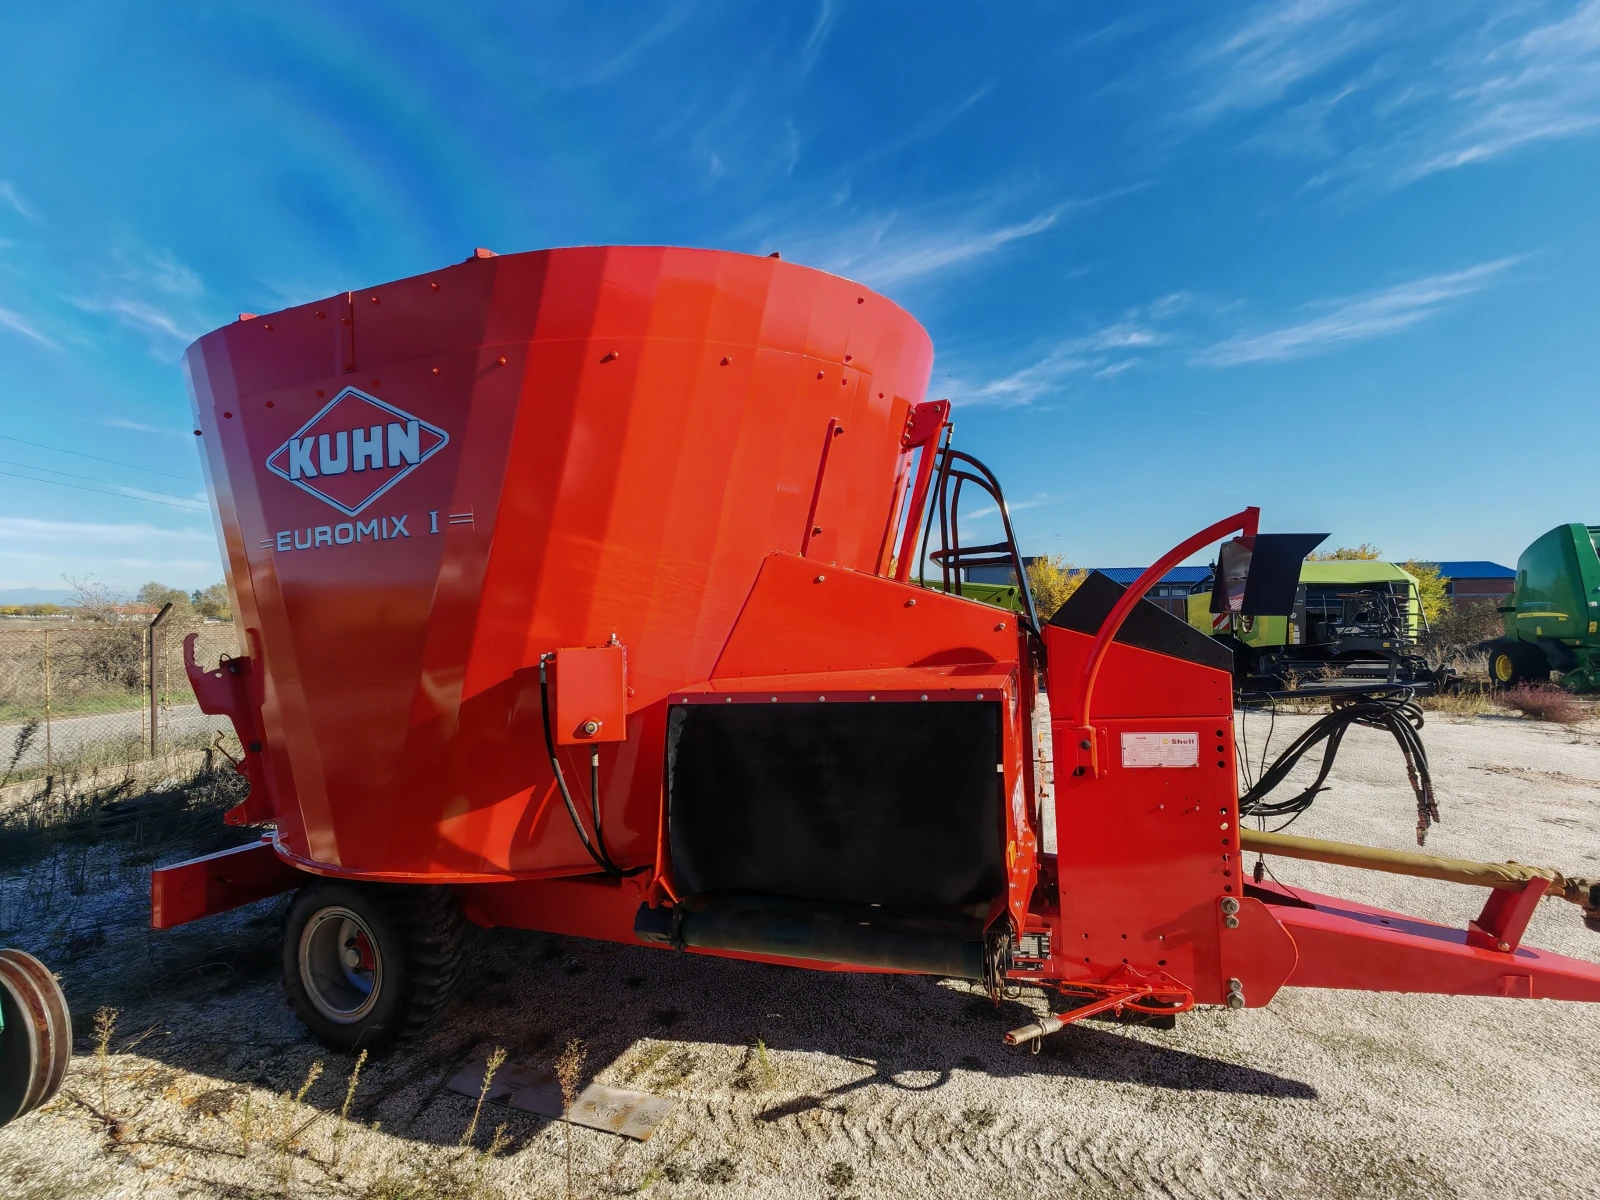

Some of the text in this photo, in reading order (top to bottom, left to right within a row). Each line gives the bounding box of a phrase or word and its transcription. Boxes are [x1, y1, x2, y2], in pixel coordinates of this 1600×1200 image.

[289, 419, 421, 481] KUHN
[276, 510, 439, 552] EUROMIX I
